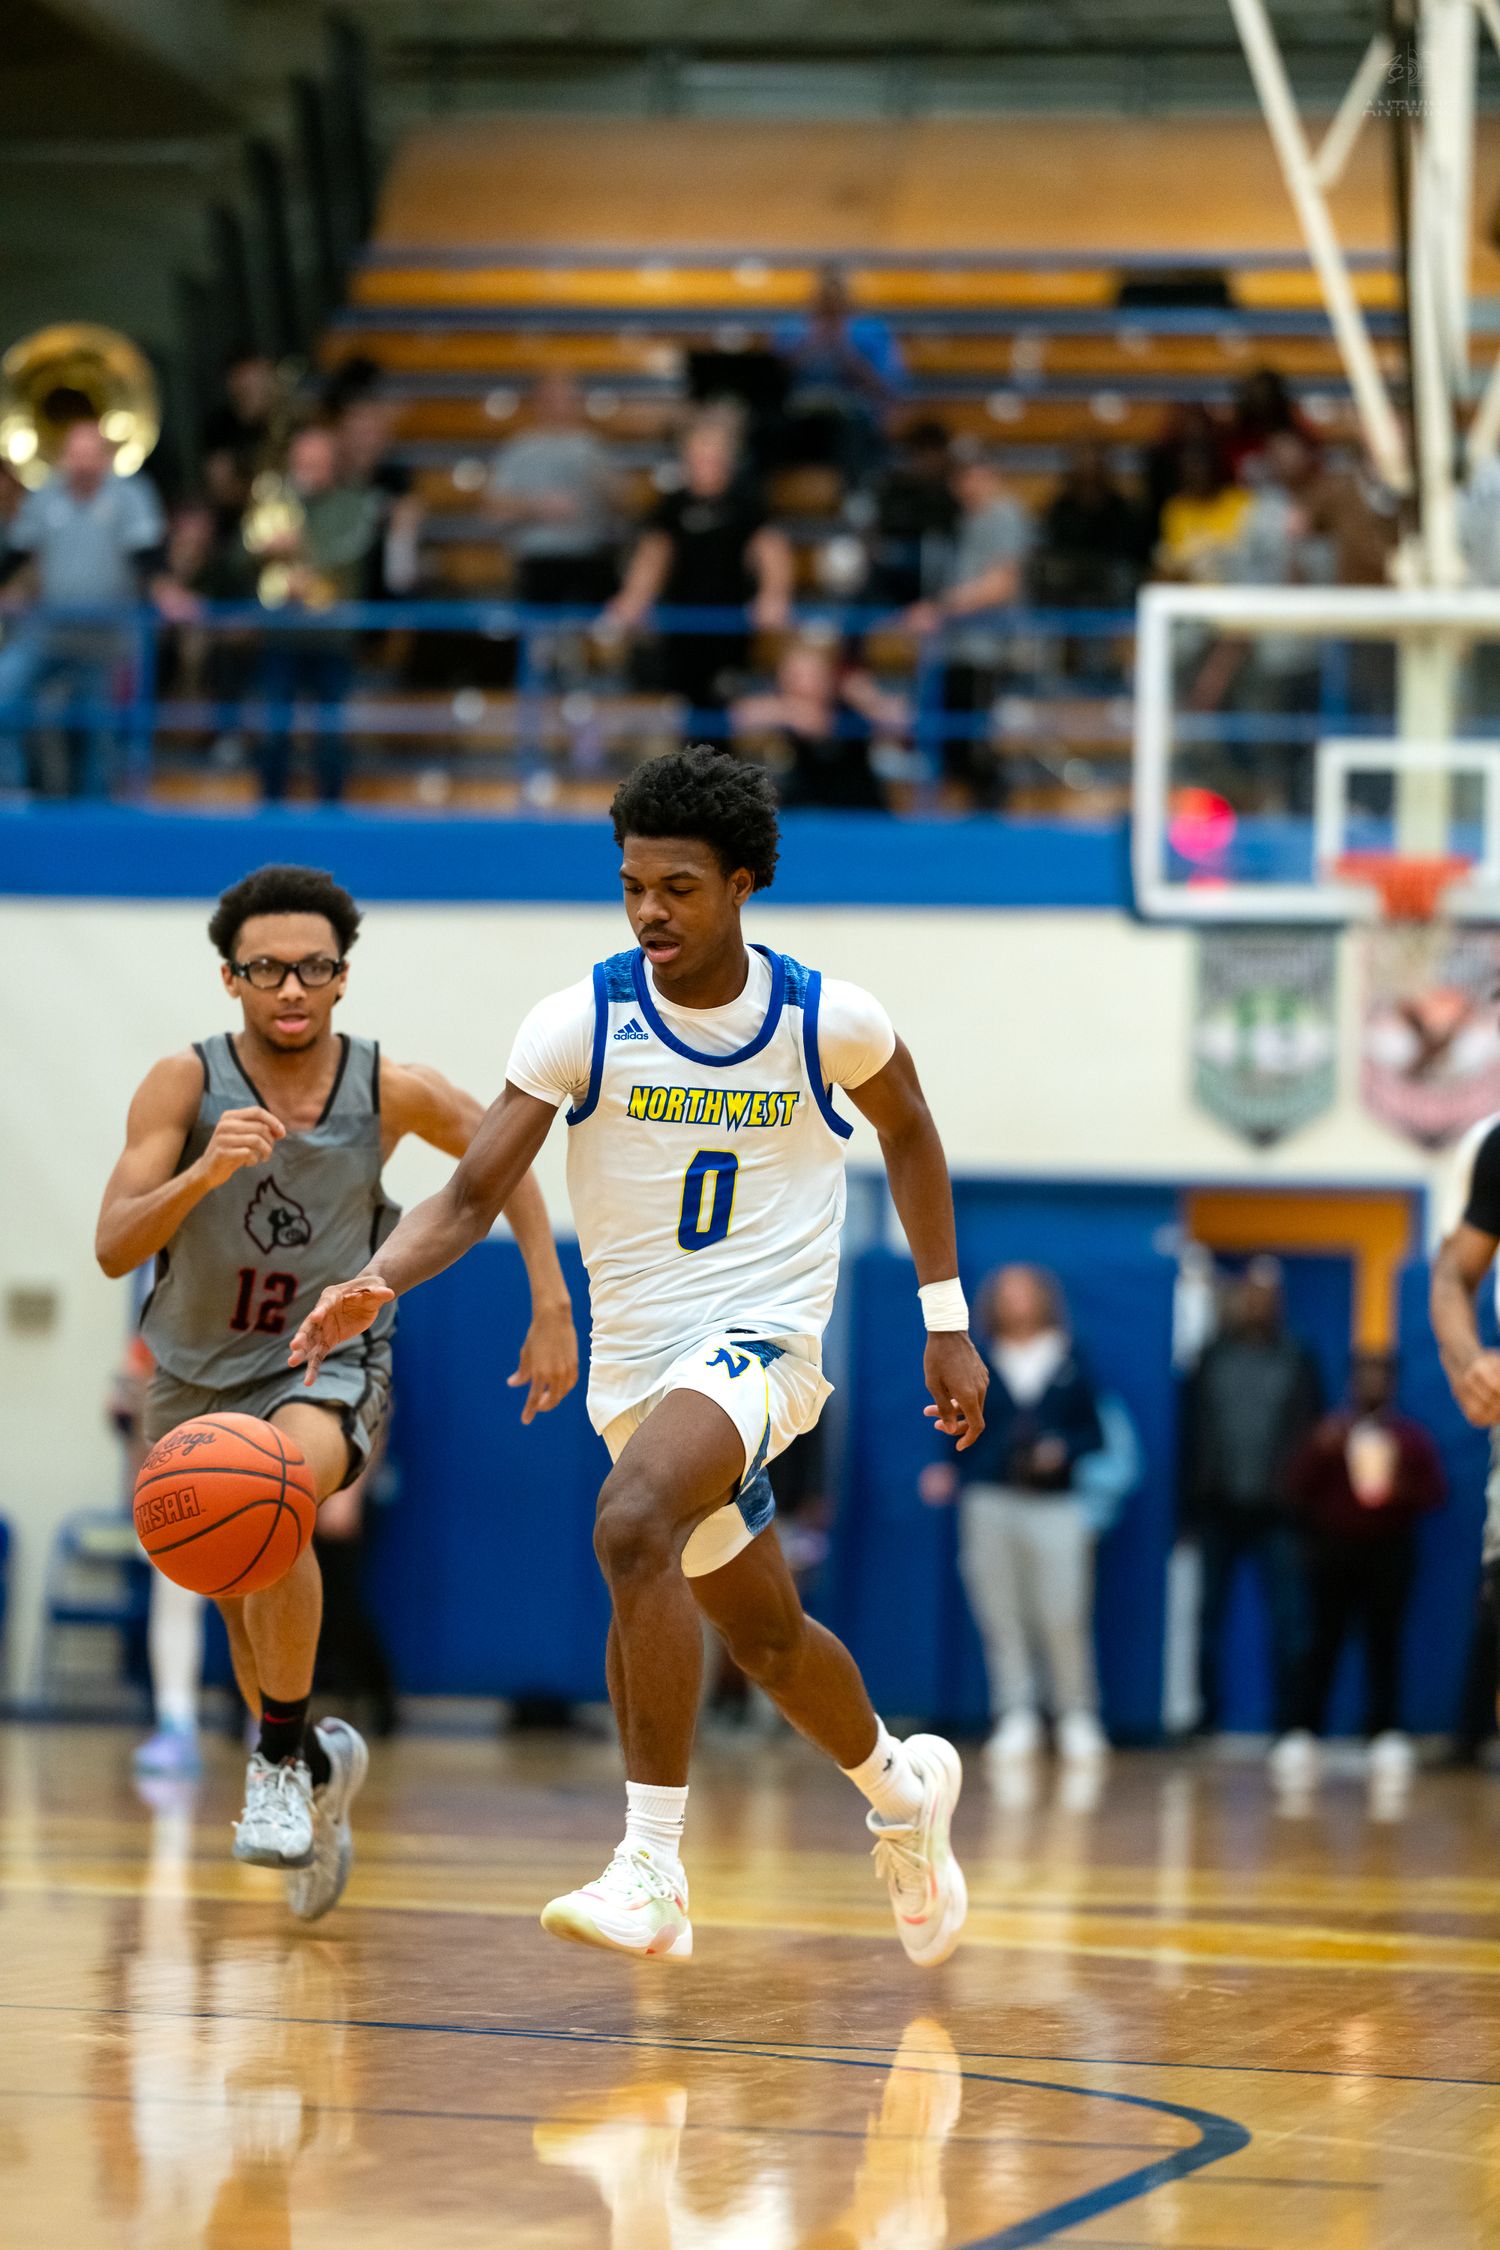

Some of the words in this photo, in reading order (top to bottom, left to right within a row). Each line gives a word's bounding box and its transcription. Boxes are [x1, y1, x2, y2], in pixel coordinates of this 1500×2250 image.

[613, 1031, 650, 1041] adidas
[626, 1085, 801, 1133] NORTHWEST
[676, 1148, 742, 1253] 0
[228, 1266, 299, 1335] 12
